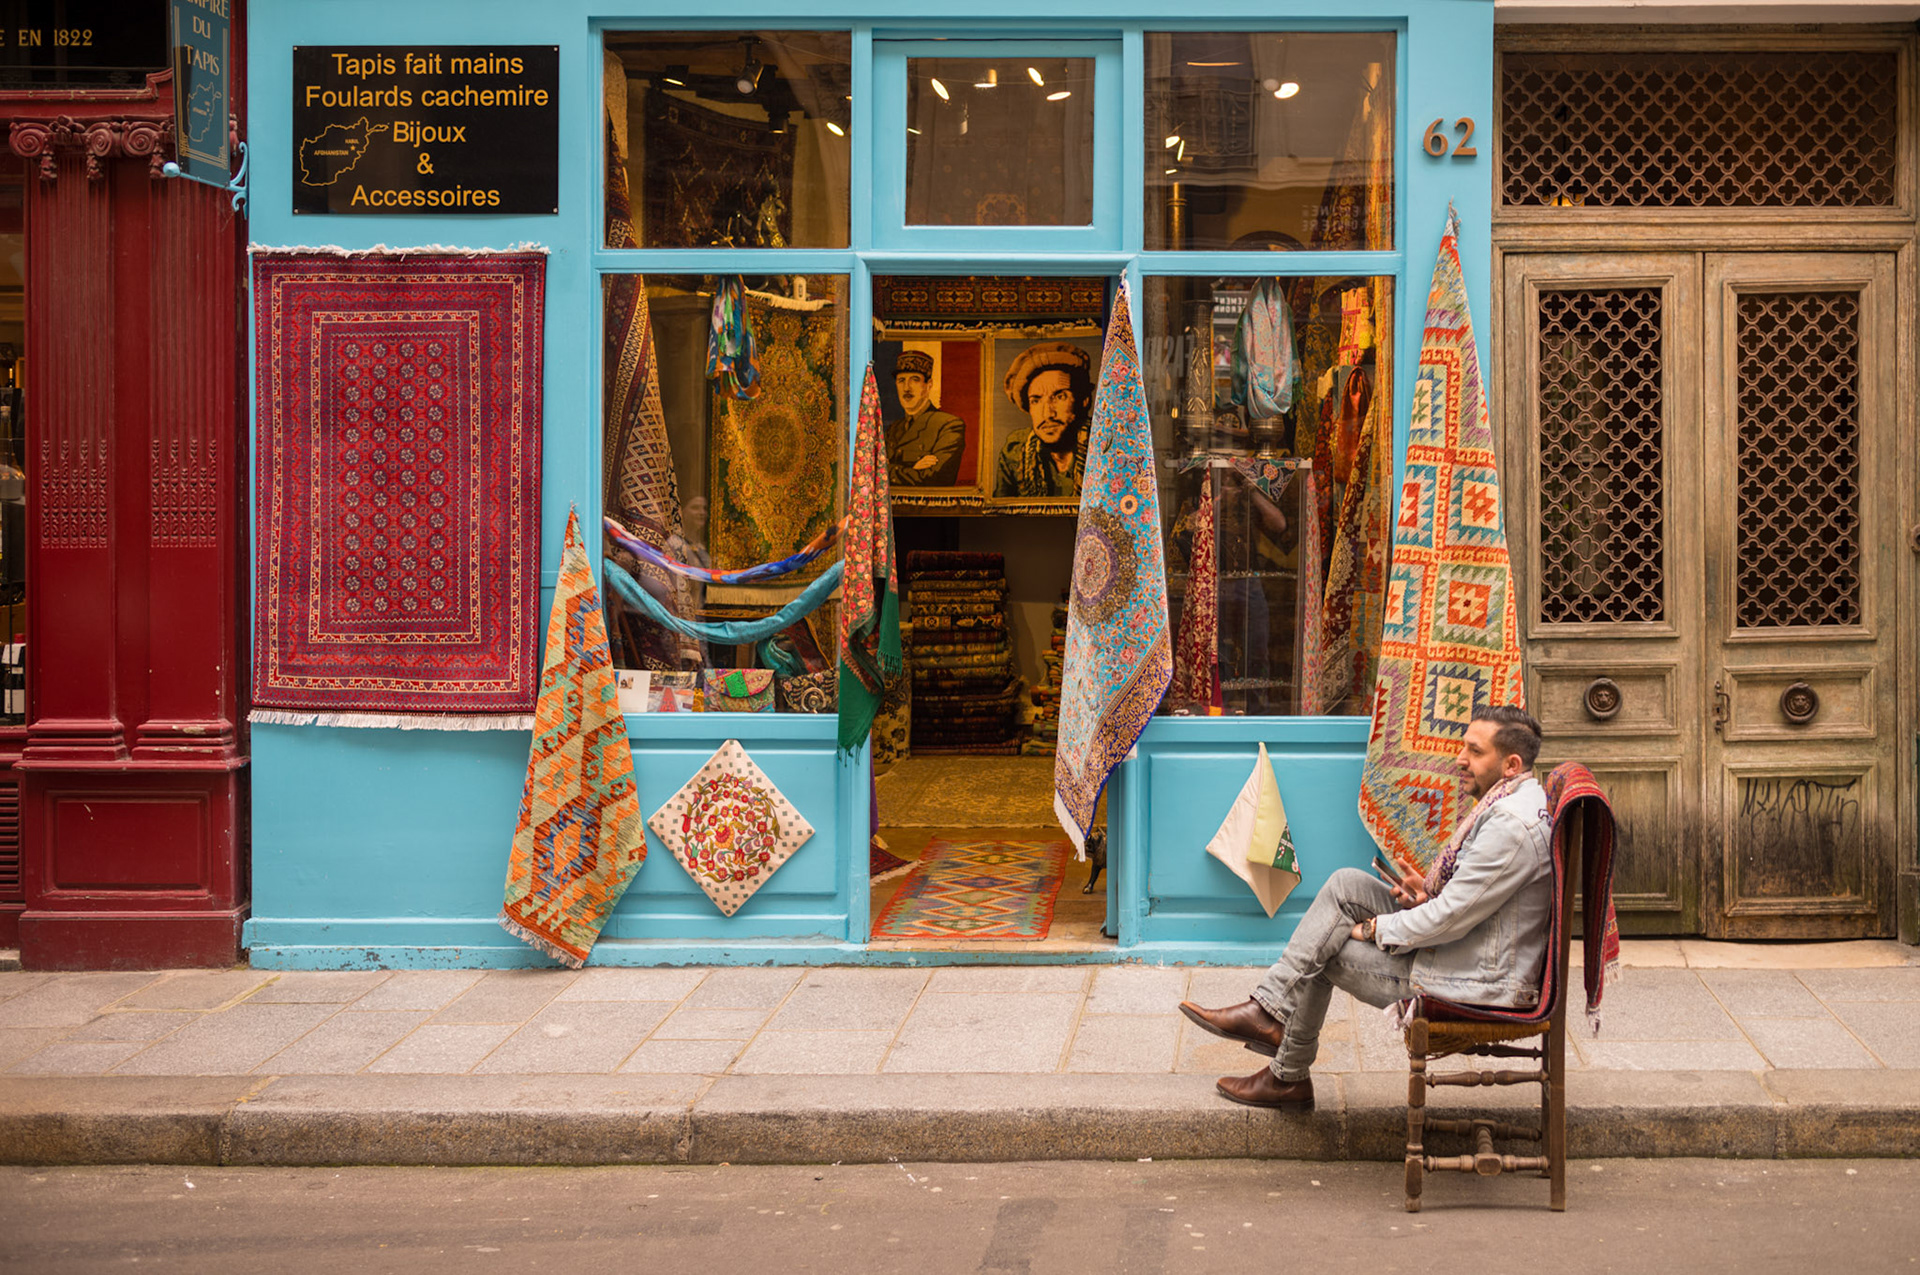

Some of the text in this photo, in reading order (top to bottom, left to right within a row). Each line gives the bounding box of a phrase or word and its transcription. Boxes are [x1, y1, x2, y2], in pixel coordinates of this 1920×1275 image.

[18, 29, 42, 47] EN
[53, 29, 93, 47] 1822
[193, 15, 211, 39] DU
[184, 43, 220, 76] TAPIS
[331, 53, 524, 80] Tapis fait mains
[306, 85, 549, 107] Foulards cachemire
[393, 121, 466, 146] Bijoux
[1423, 116, 1478, 157] 62
[416, 153, 435, 175] &
[350, 184, 501, 207] Accessoires
